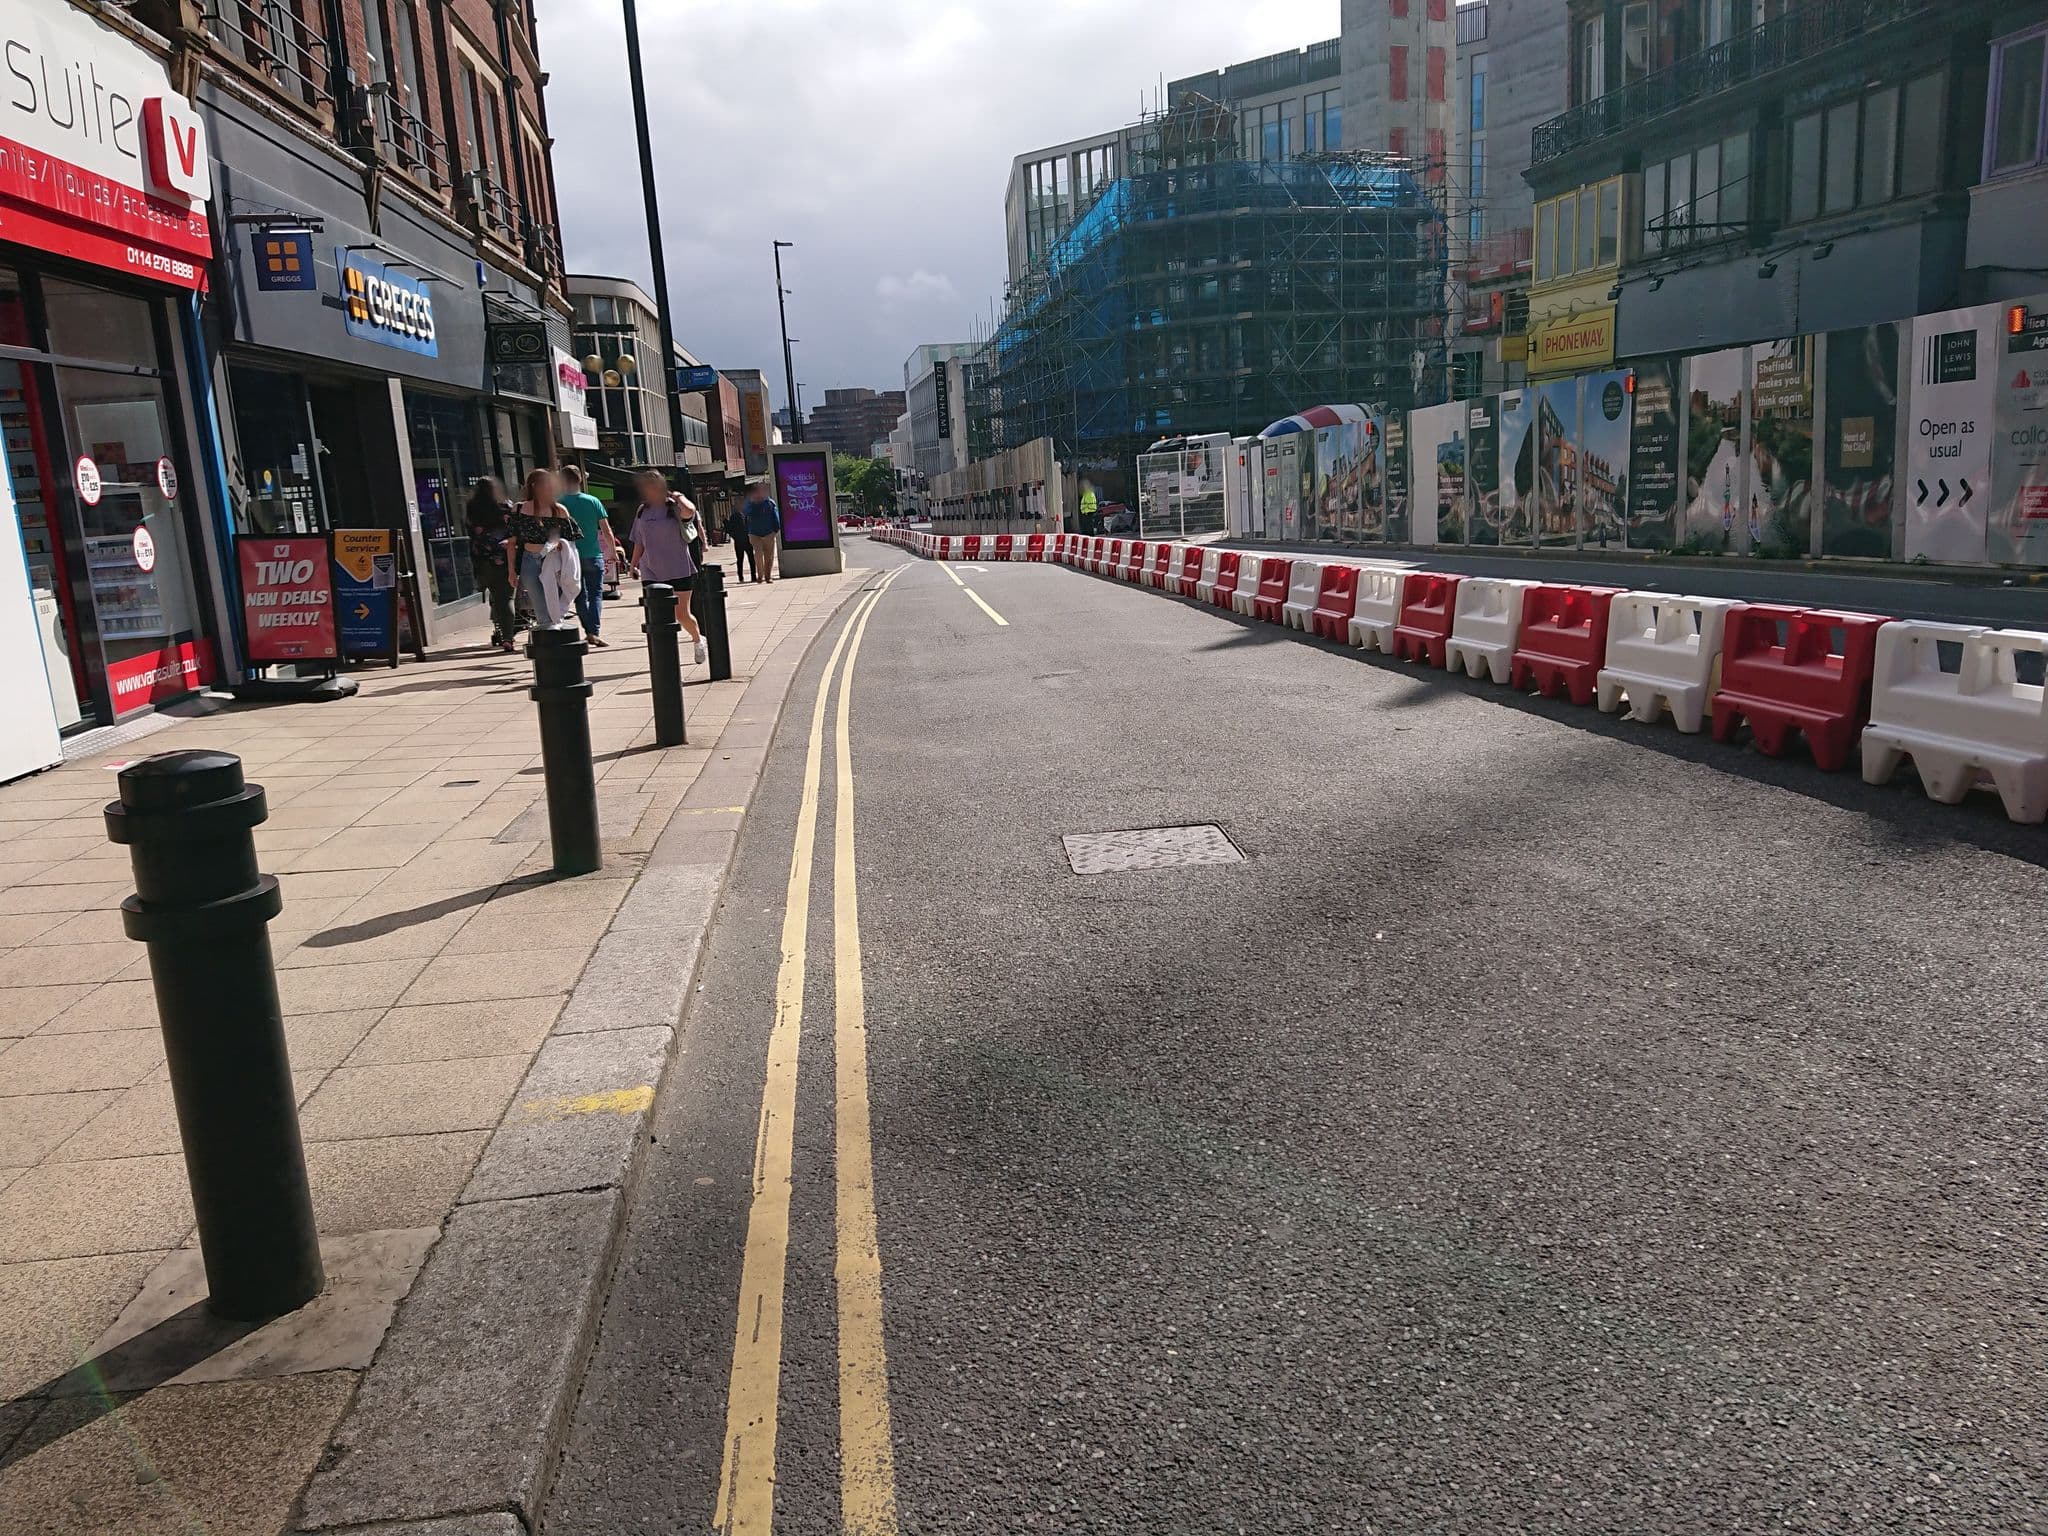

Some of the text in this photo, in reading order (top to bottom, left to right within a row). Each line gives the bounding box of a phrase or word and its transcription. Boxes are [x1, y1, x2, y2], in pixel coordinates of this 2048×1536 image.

[169, 115, 196, 177] V
[127, 246, 152, 268] 0114
[271, 275, 302, 283] GREGGS
[366, 276, 435, 340] GREGGS
[1546, 328, 1605, 353] PHONEWAY
[1947, 339, 1970, 350] JOHN
[1759, 359, 1793, 373] Sheffield
[1944, 352, 1972, 363] LEWIS
[1758, 376, 1801, 390] makes you
[936, 366, 948, 434] DEBENHAMS
[1758, 391, 1803, 407] think again
[1920, 419, 1975, 440] Open as
[1930, 440, 1962, 458] usual
[342, 534, 383, 544] Counter
[345, 544, 381, 554] service
[255, 559, 314, 586] TWO
[246, 590, 329, 608] NEW DEALS
[259, 611, 321, 628] WEEKLY!
